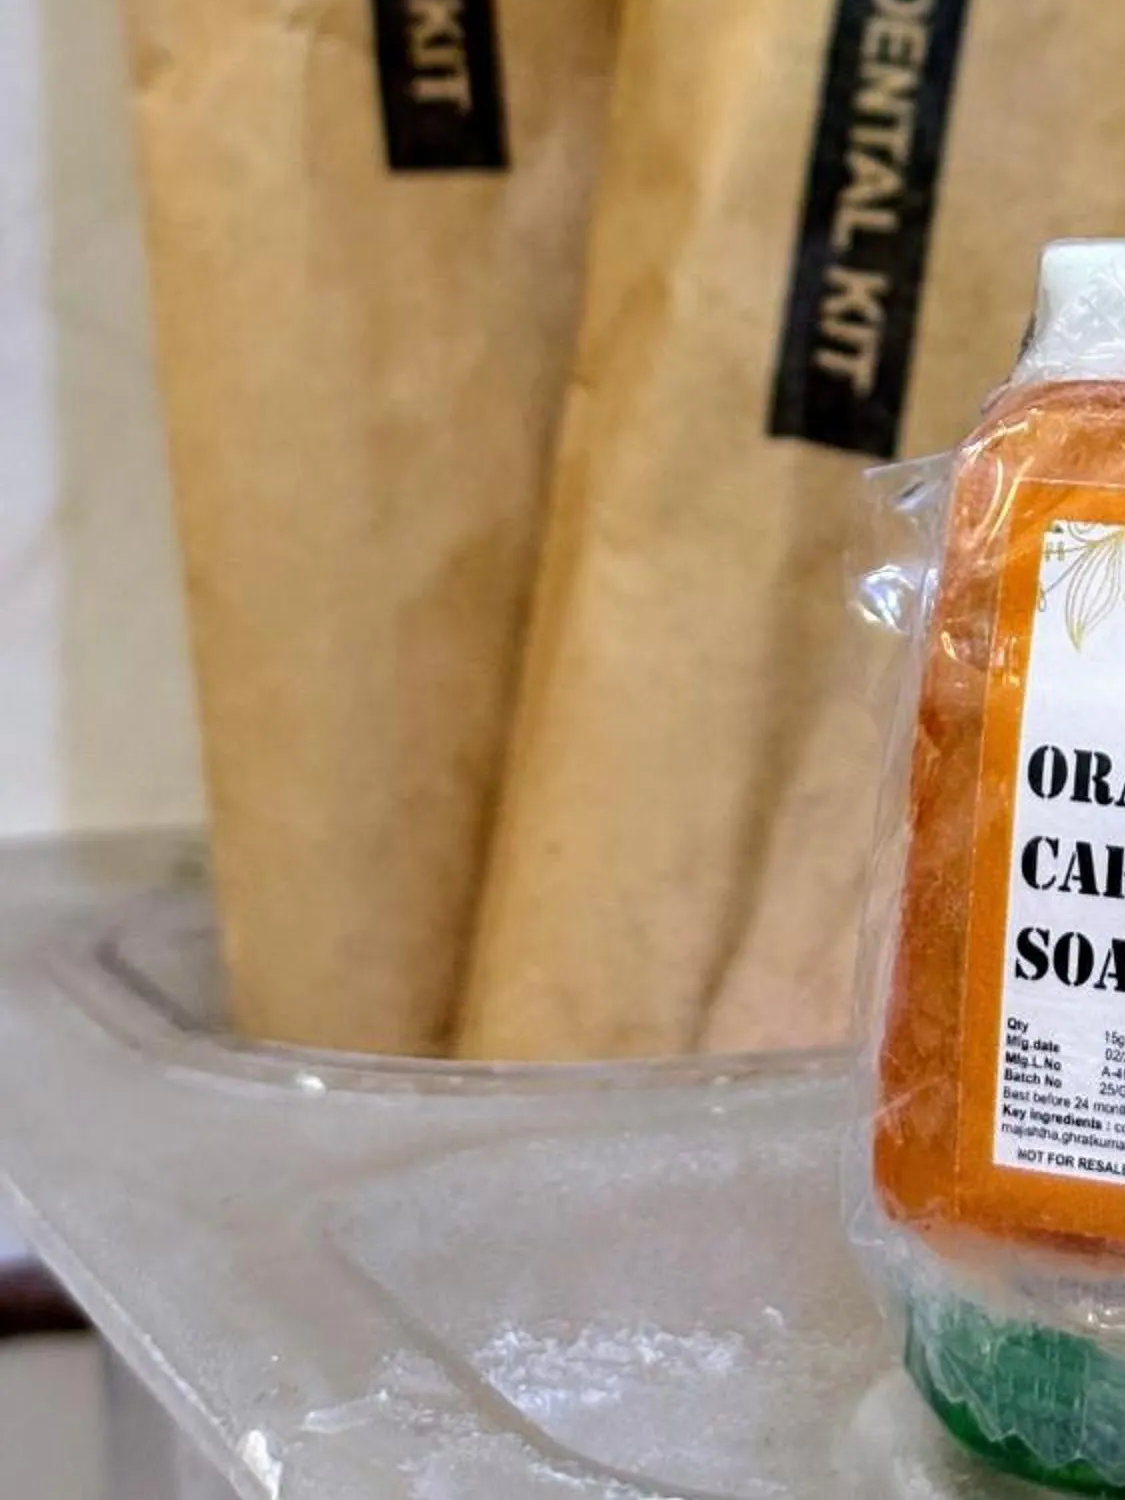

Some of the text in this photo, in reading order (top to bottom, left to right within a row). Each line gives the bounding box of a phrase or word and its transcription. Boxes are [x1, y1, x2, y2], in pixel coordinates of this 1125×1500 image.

[813, 264, 892, 398] KIT
[1007, 1017, 1029, 1033] Qty
[1004, 1068, 1041, 1085] Batch
[1044, 1072, 1063, 1089] No
[1003, 1086, 1030, 1101] Best
[1033, 1091, 1071, 1108] before
[1074, 1096, 1089, 1110] 24
[1002, 1103, 1026, 1120] Key
[1030, 1108, 1103, 1130] ingredients
[1017, 1146, 1044, 1163] NOT
[1047, 1153, 1075, 1168] FOR
